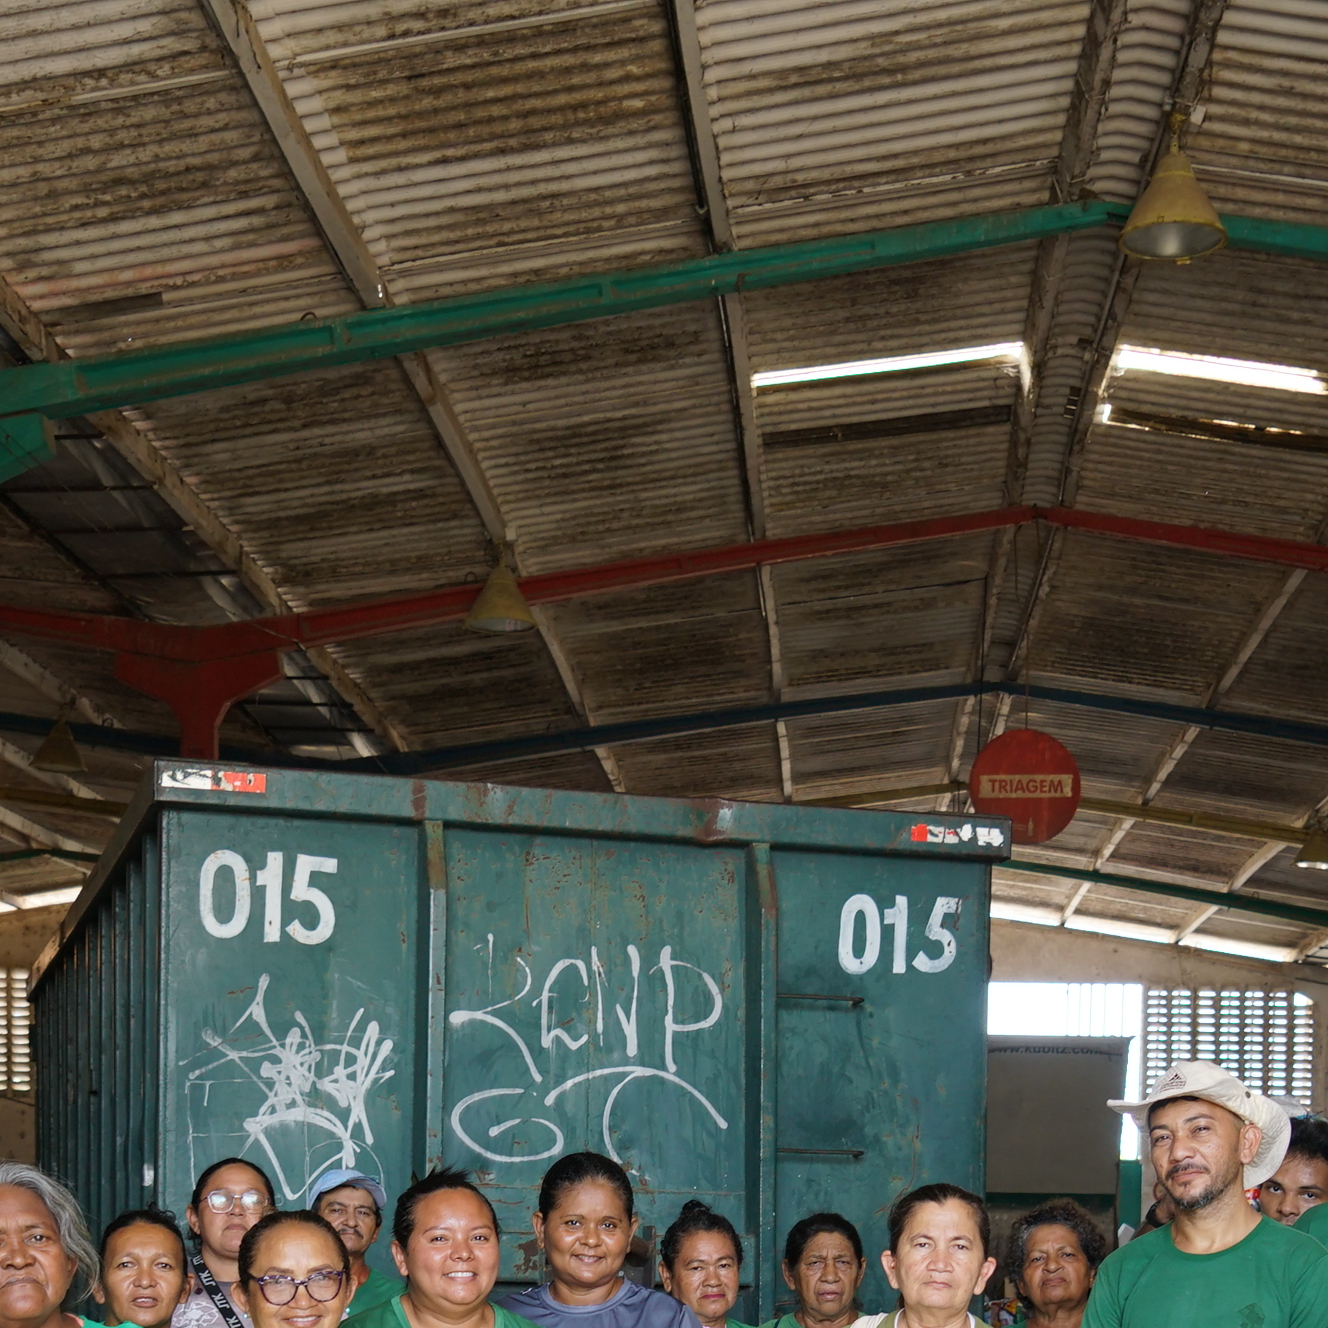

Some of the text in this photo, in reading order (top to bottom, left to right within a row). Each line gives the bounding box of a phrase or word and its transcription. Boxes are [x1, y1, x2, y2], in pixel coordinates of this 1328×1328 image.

[987, 778, 1064, 795] TRIAGEM
[199, 849, 338, 945] 015
[838, 893, 963, 975] 015
